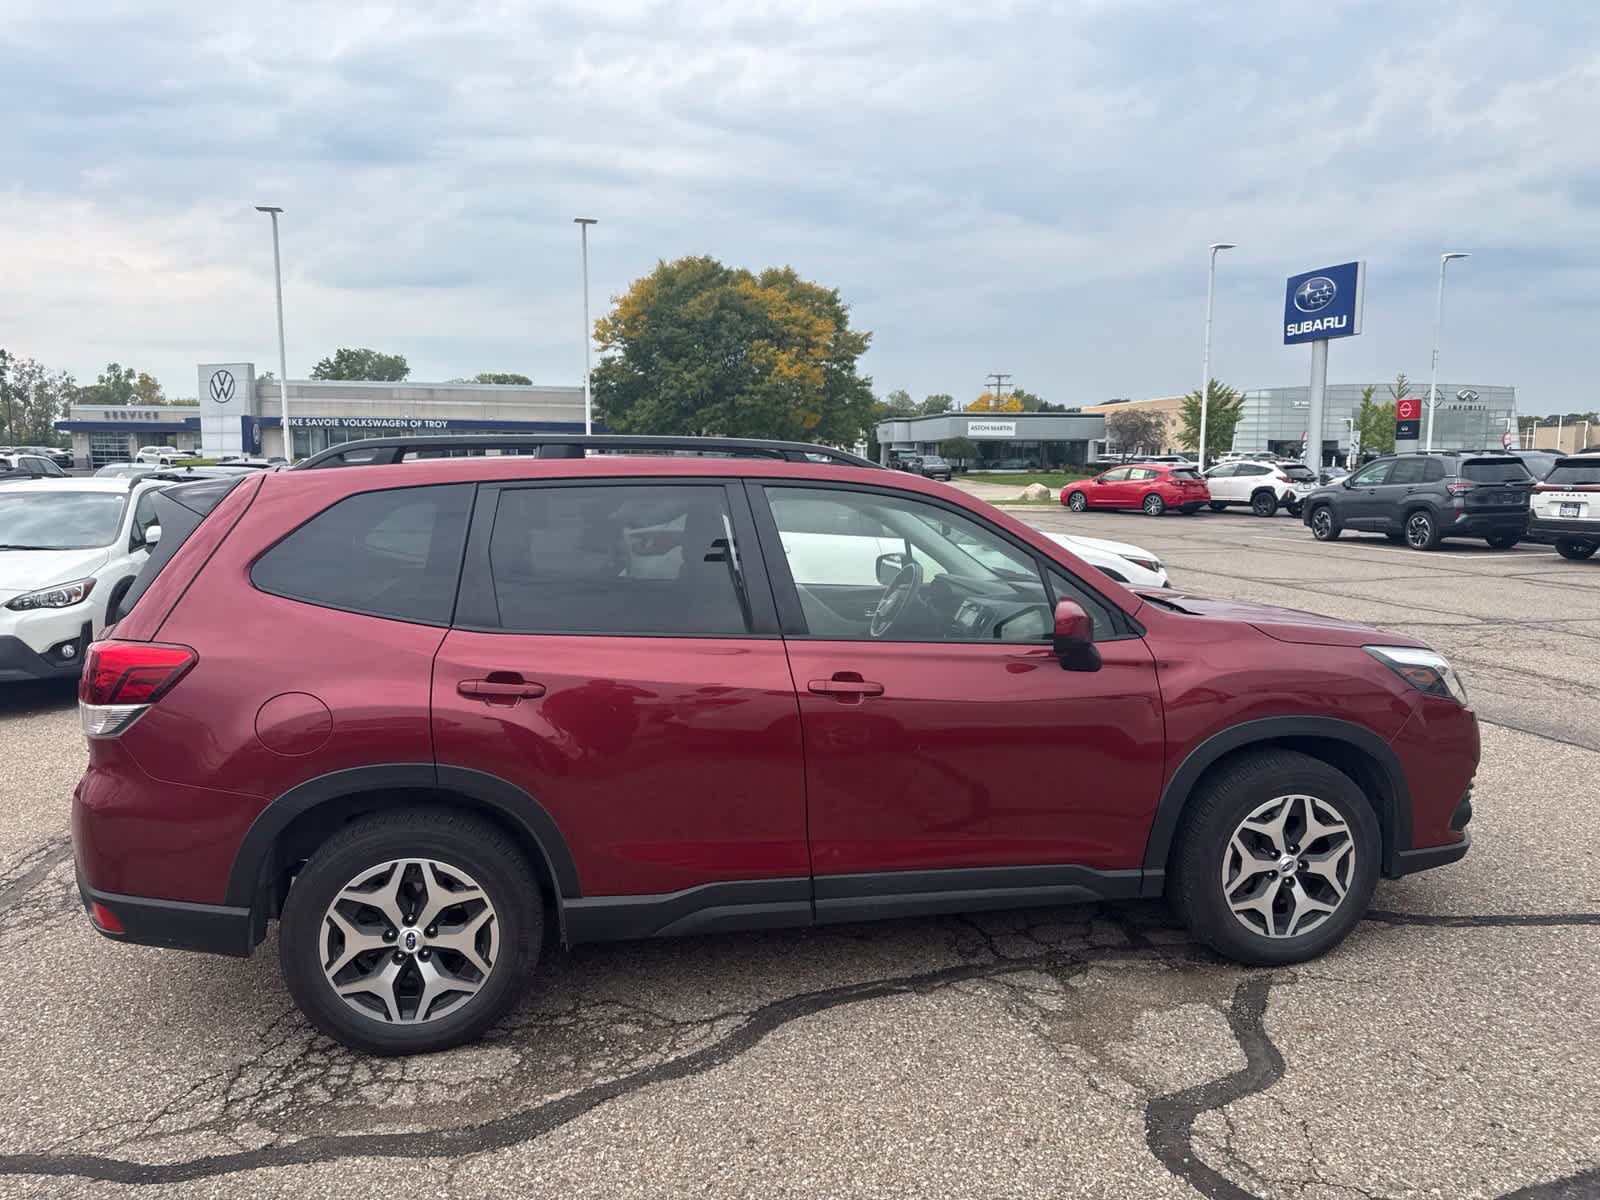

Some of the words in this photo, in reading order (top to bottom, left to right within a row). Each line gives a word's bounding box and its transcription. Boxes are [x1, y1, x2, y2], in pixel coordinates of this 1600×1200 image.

[1286, 314, 1347, 337] SUBARU
[104, 410, 160, 420] SERVICE
[305, 418, 340, 427] SAVOIE
[342, 418, 408, 428] VOLKSWAGEN
[410, 419, 422, 428] OF
[424, 420, 448, 428] TROY
